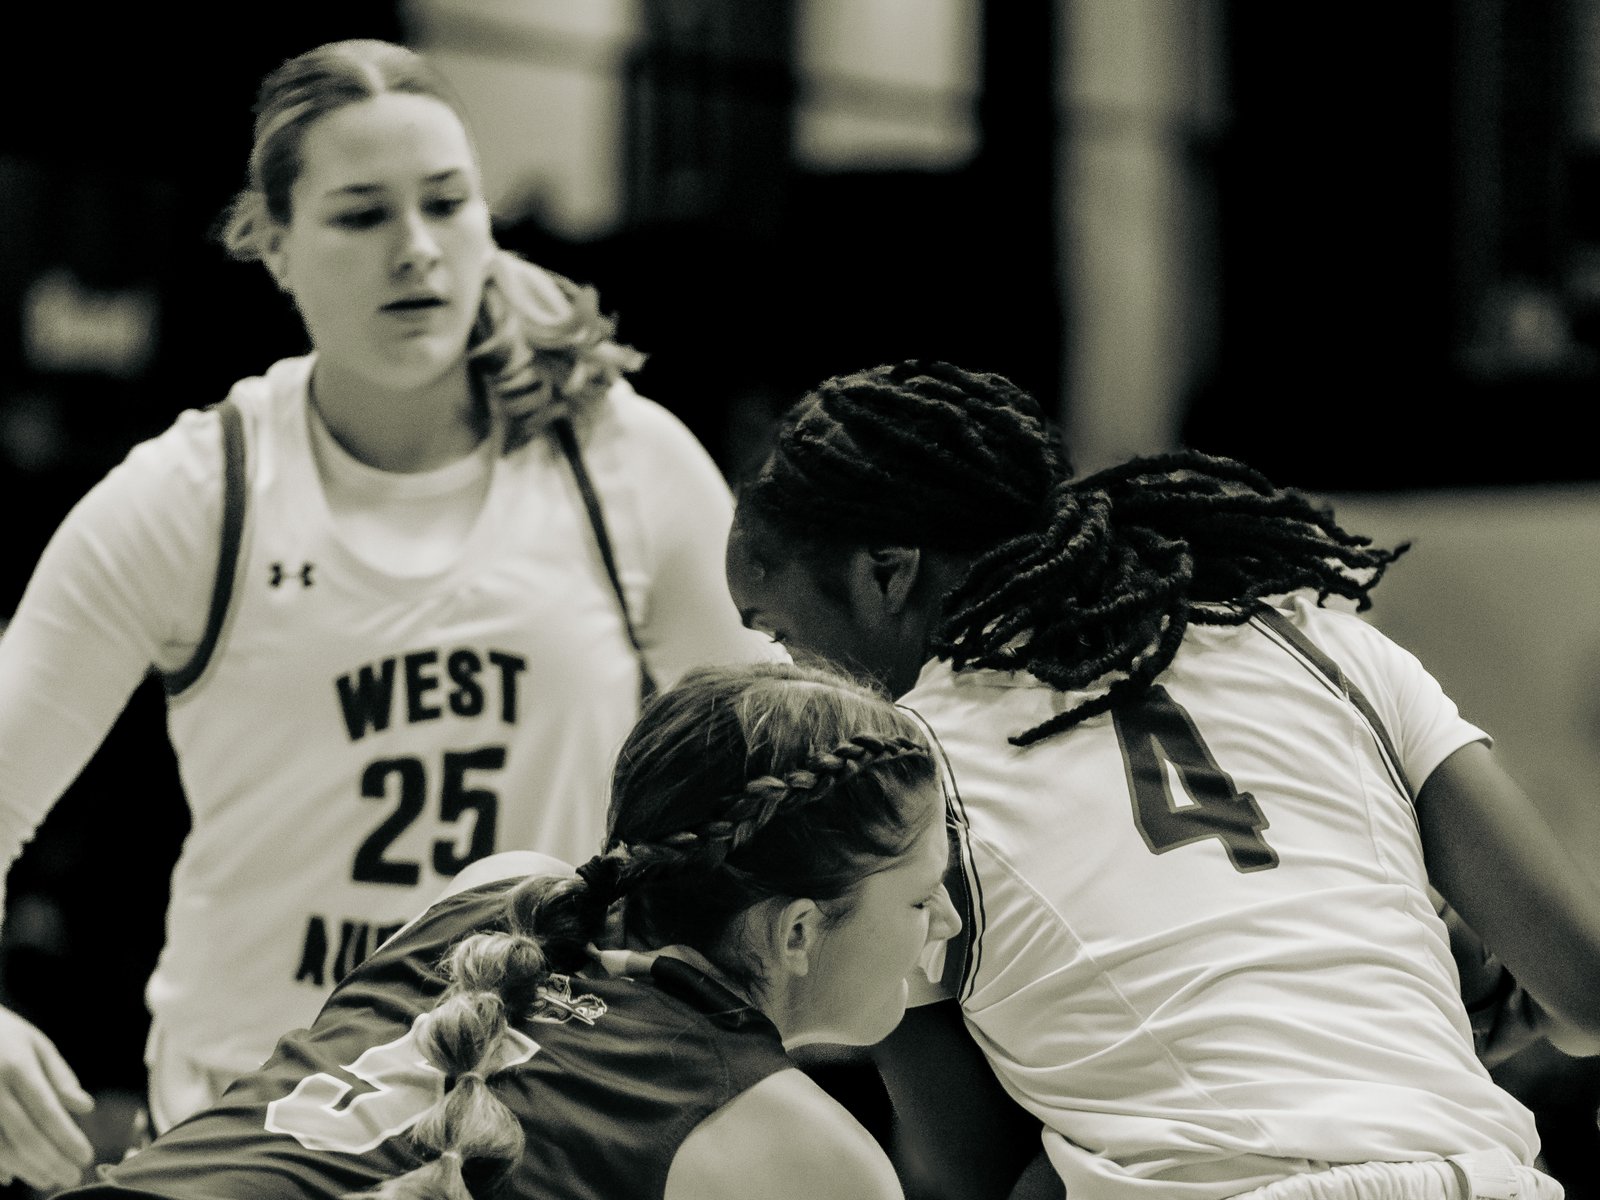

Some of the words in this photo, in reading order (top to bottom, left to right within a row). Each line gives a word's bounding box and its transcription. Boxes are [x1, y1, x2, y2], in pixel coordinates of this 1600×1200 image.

[335, 647, 527, 741] WEST
[352, 746, 506, 887] 25
[1111, 683, 1280, 874] 4
